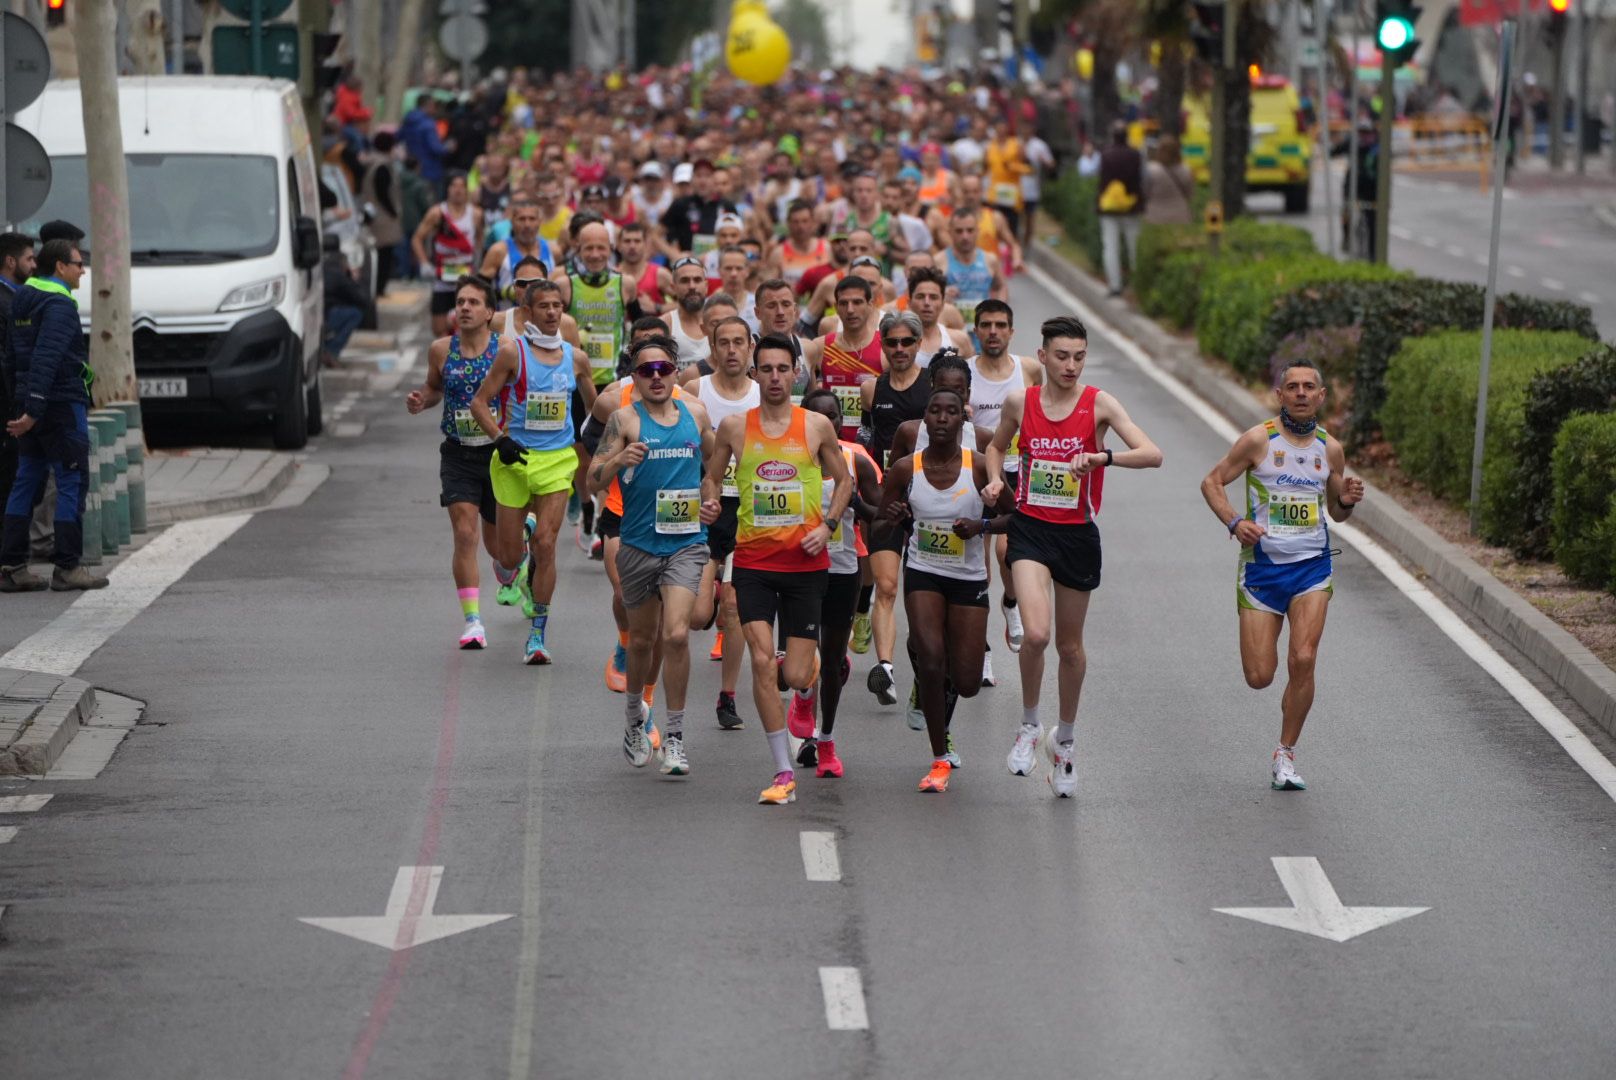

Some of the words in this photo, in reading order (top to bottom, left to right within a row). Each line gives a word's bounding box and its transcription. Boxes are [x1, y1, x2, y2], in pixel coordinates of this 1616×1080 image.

[537, 402, 559, 416] 115
[648, 448, 694, 460] ANTISOCIAL
[761, 466, 794, 476] Serrano
[1044, 473, 1064, 489] 35
[1033, 487, 1051, 496] HUGO
[671, 501, 689, 517] 32
[768, 493, 787, 509] 10
[1280, 504, 1309, 520] 106
[931, 532, 949, 549] 22
